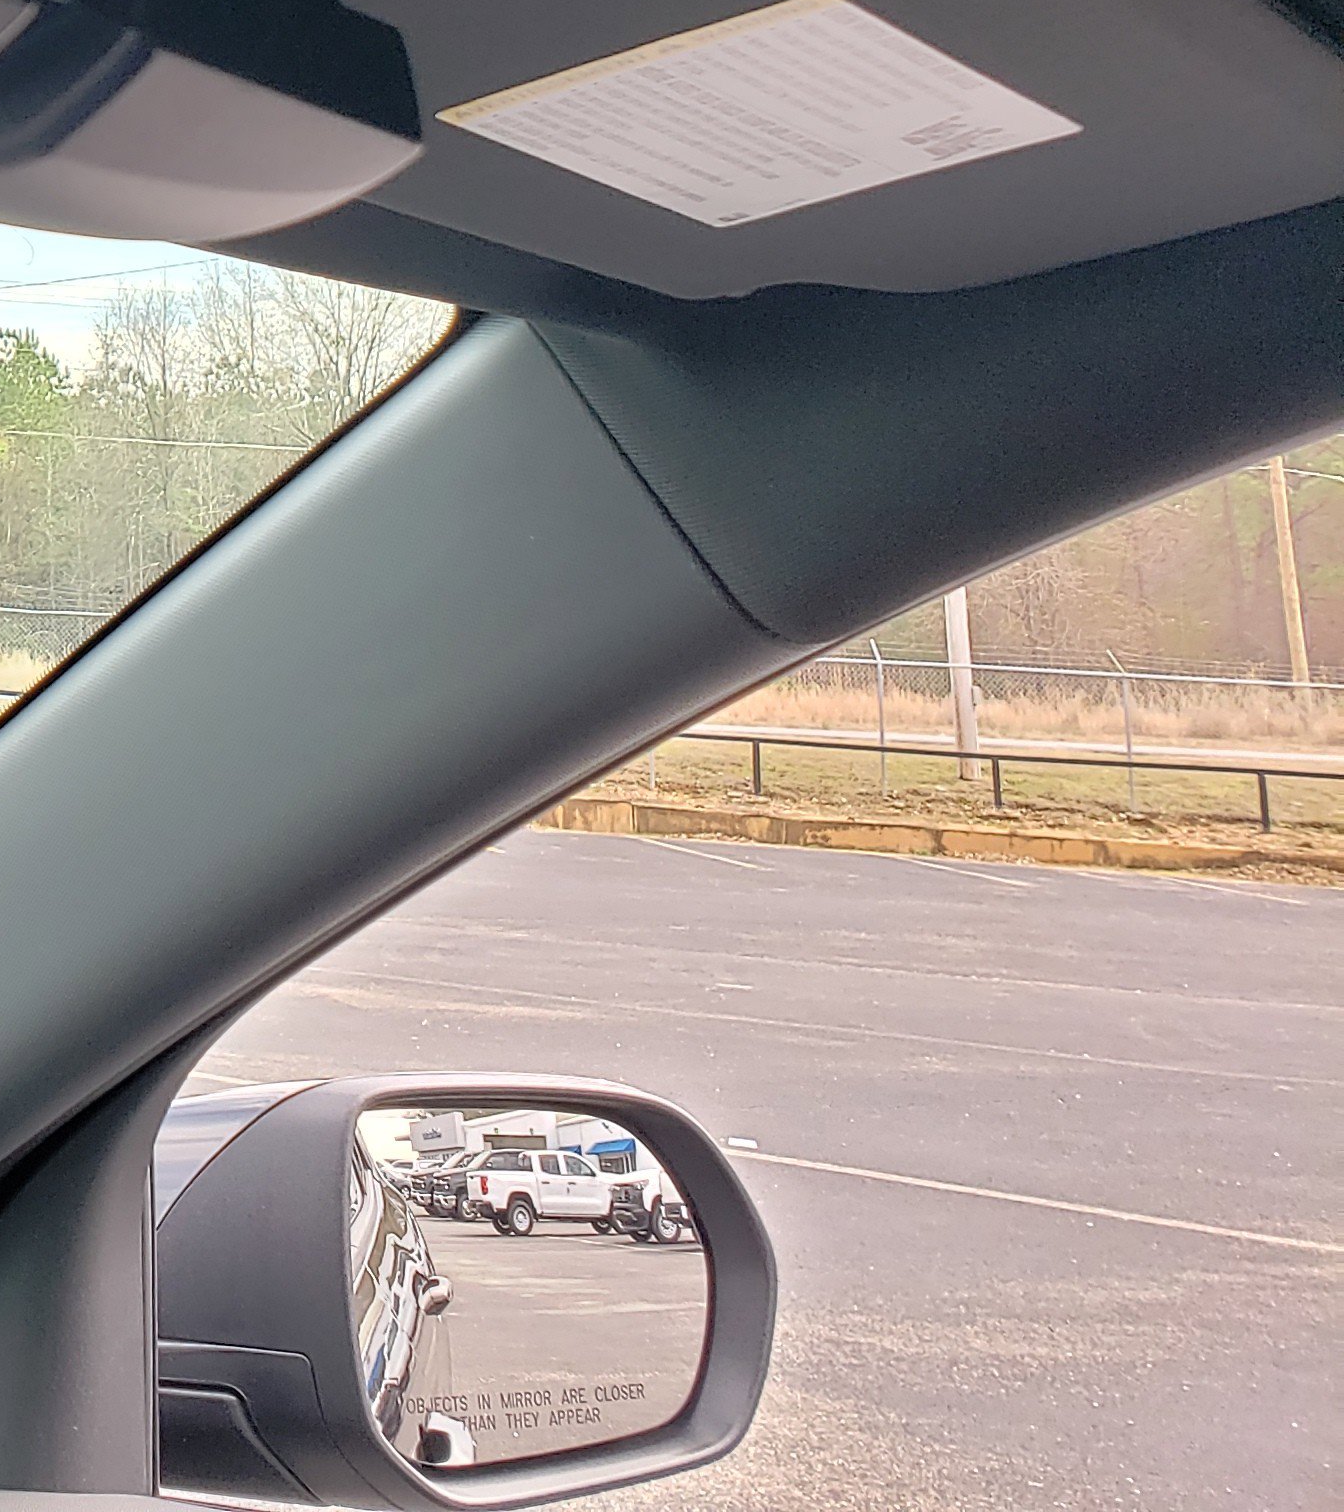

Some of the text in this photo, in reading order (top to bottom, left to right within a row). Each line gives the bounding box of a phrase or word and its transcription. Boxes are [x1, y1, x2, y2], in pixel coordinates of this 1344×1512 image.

[406, 1383, 646, 1414] OBJECTS IN MIRROR ARE CLOSER
[505, 1411, 539, 1429] THEY
[549, 1406, 601, 1426] APPEAR
